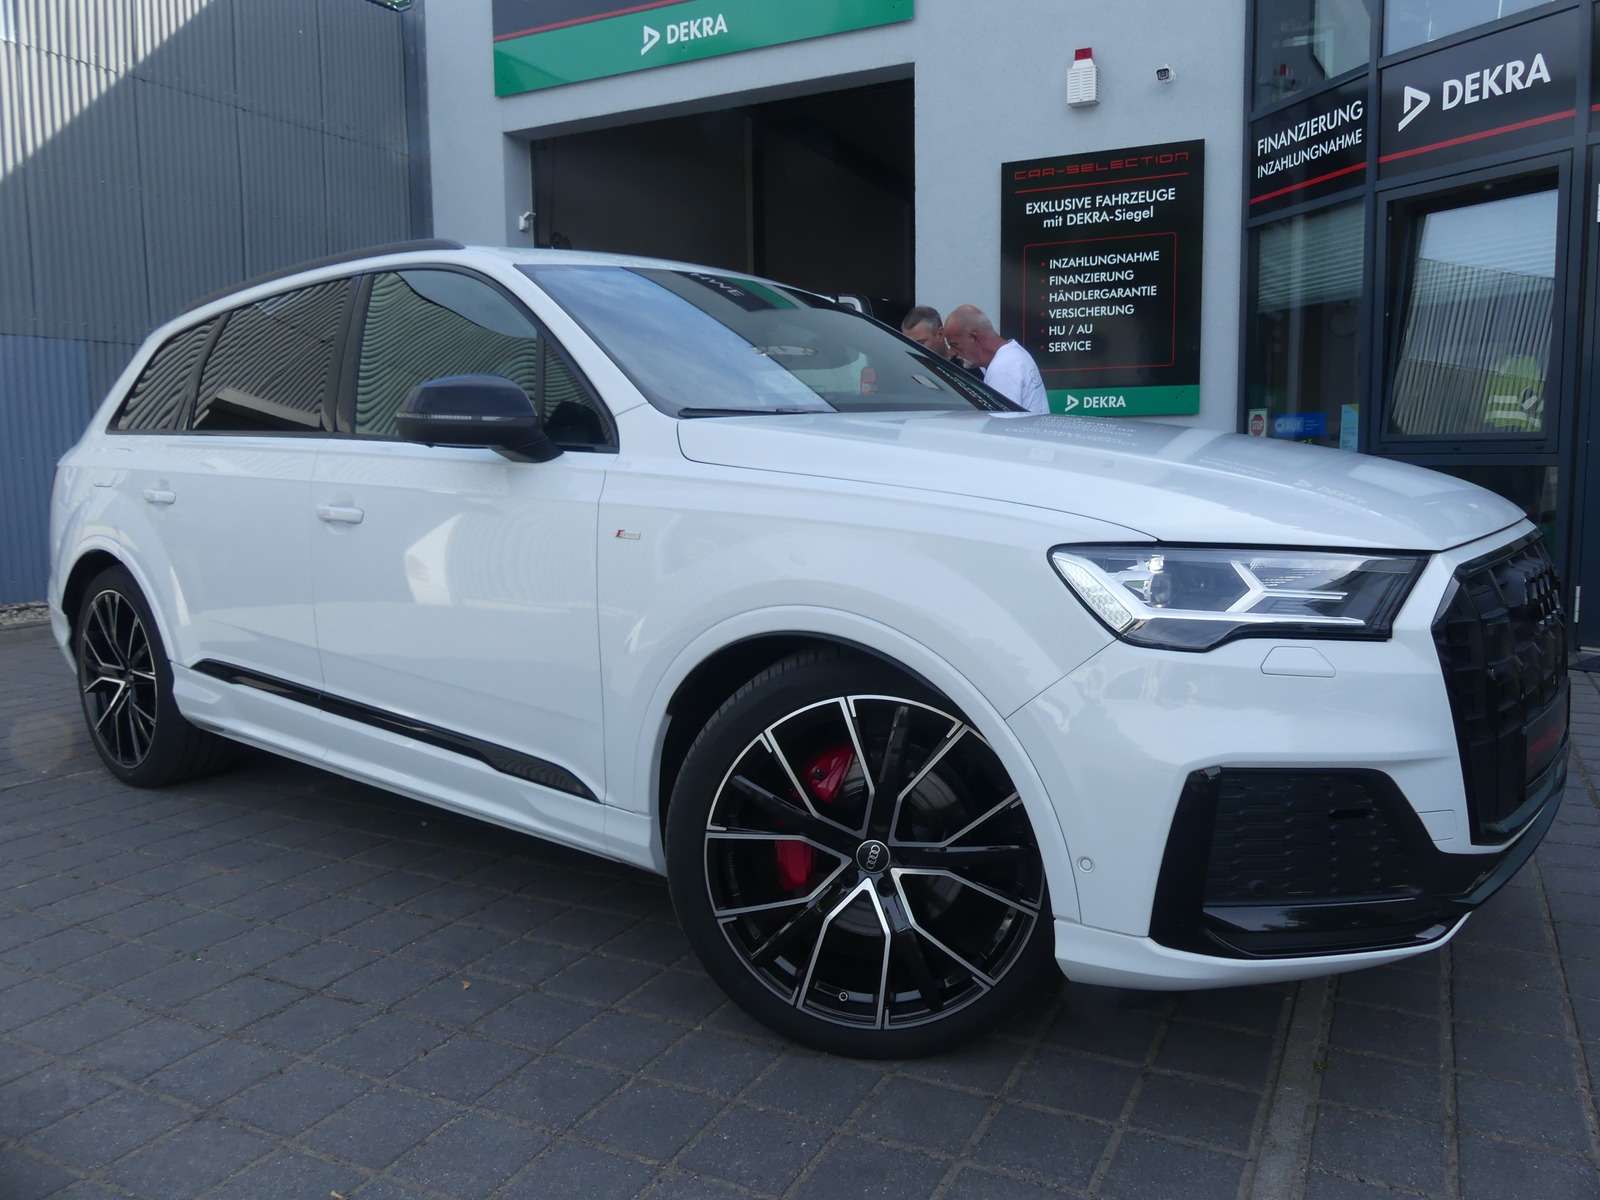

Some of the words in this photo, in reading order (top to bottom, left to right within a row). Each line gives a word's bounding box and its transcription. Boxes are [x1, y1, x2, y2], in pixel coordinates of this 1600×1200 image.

[667, 13, 728, 45] DEKRA
[1442, 52, 1552, 111] DEKRA
[1257, 100, 1364, 157] FINANZIERUNG
[1257, 128, 1363, 179] INZAHLUNGNAHME
[1025, 197, 1092, 215] EXKLUSIVE
[1095, 187, 1176, 208] FAHRZEUGE
[1043, 215, 1063, 228] mit
[1066, 206, 1154, 227] DEKRA-Siegel
[1049, 250, 1160, 270] INZAHLUNGNAHME
[1049, 270, 1135, 286] FINANZIERUNG
[1049, 285, 1158, 303] HÄNDLERGARANTIE
[1049, 304, 1135, 320] VERSICHERUNG
[1049, 325, 1066, 336] HU
[1076, 323, 1094, 335] AU
[1048, 340, 1093, 353] SERVICE
[1083, 395, 1127, 409] DEKRA
